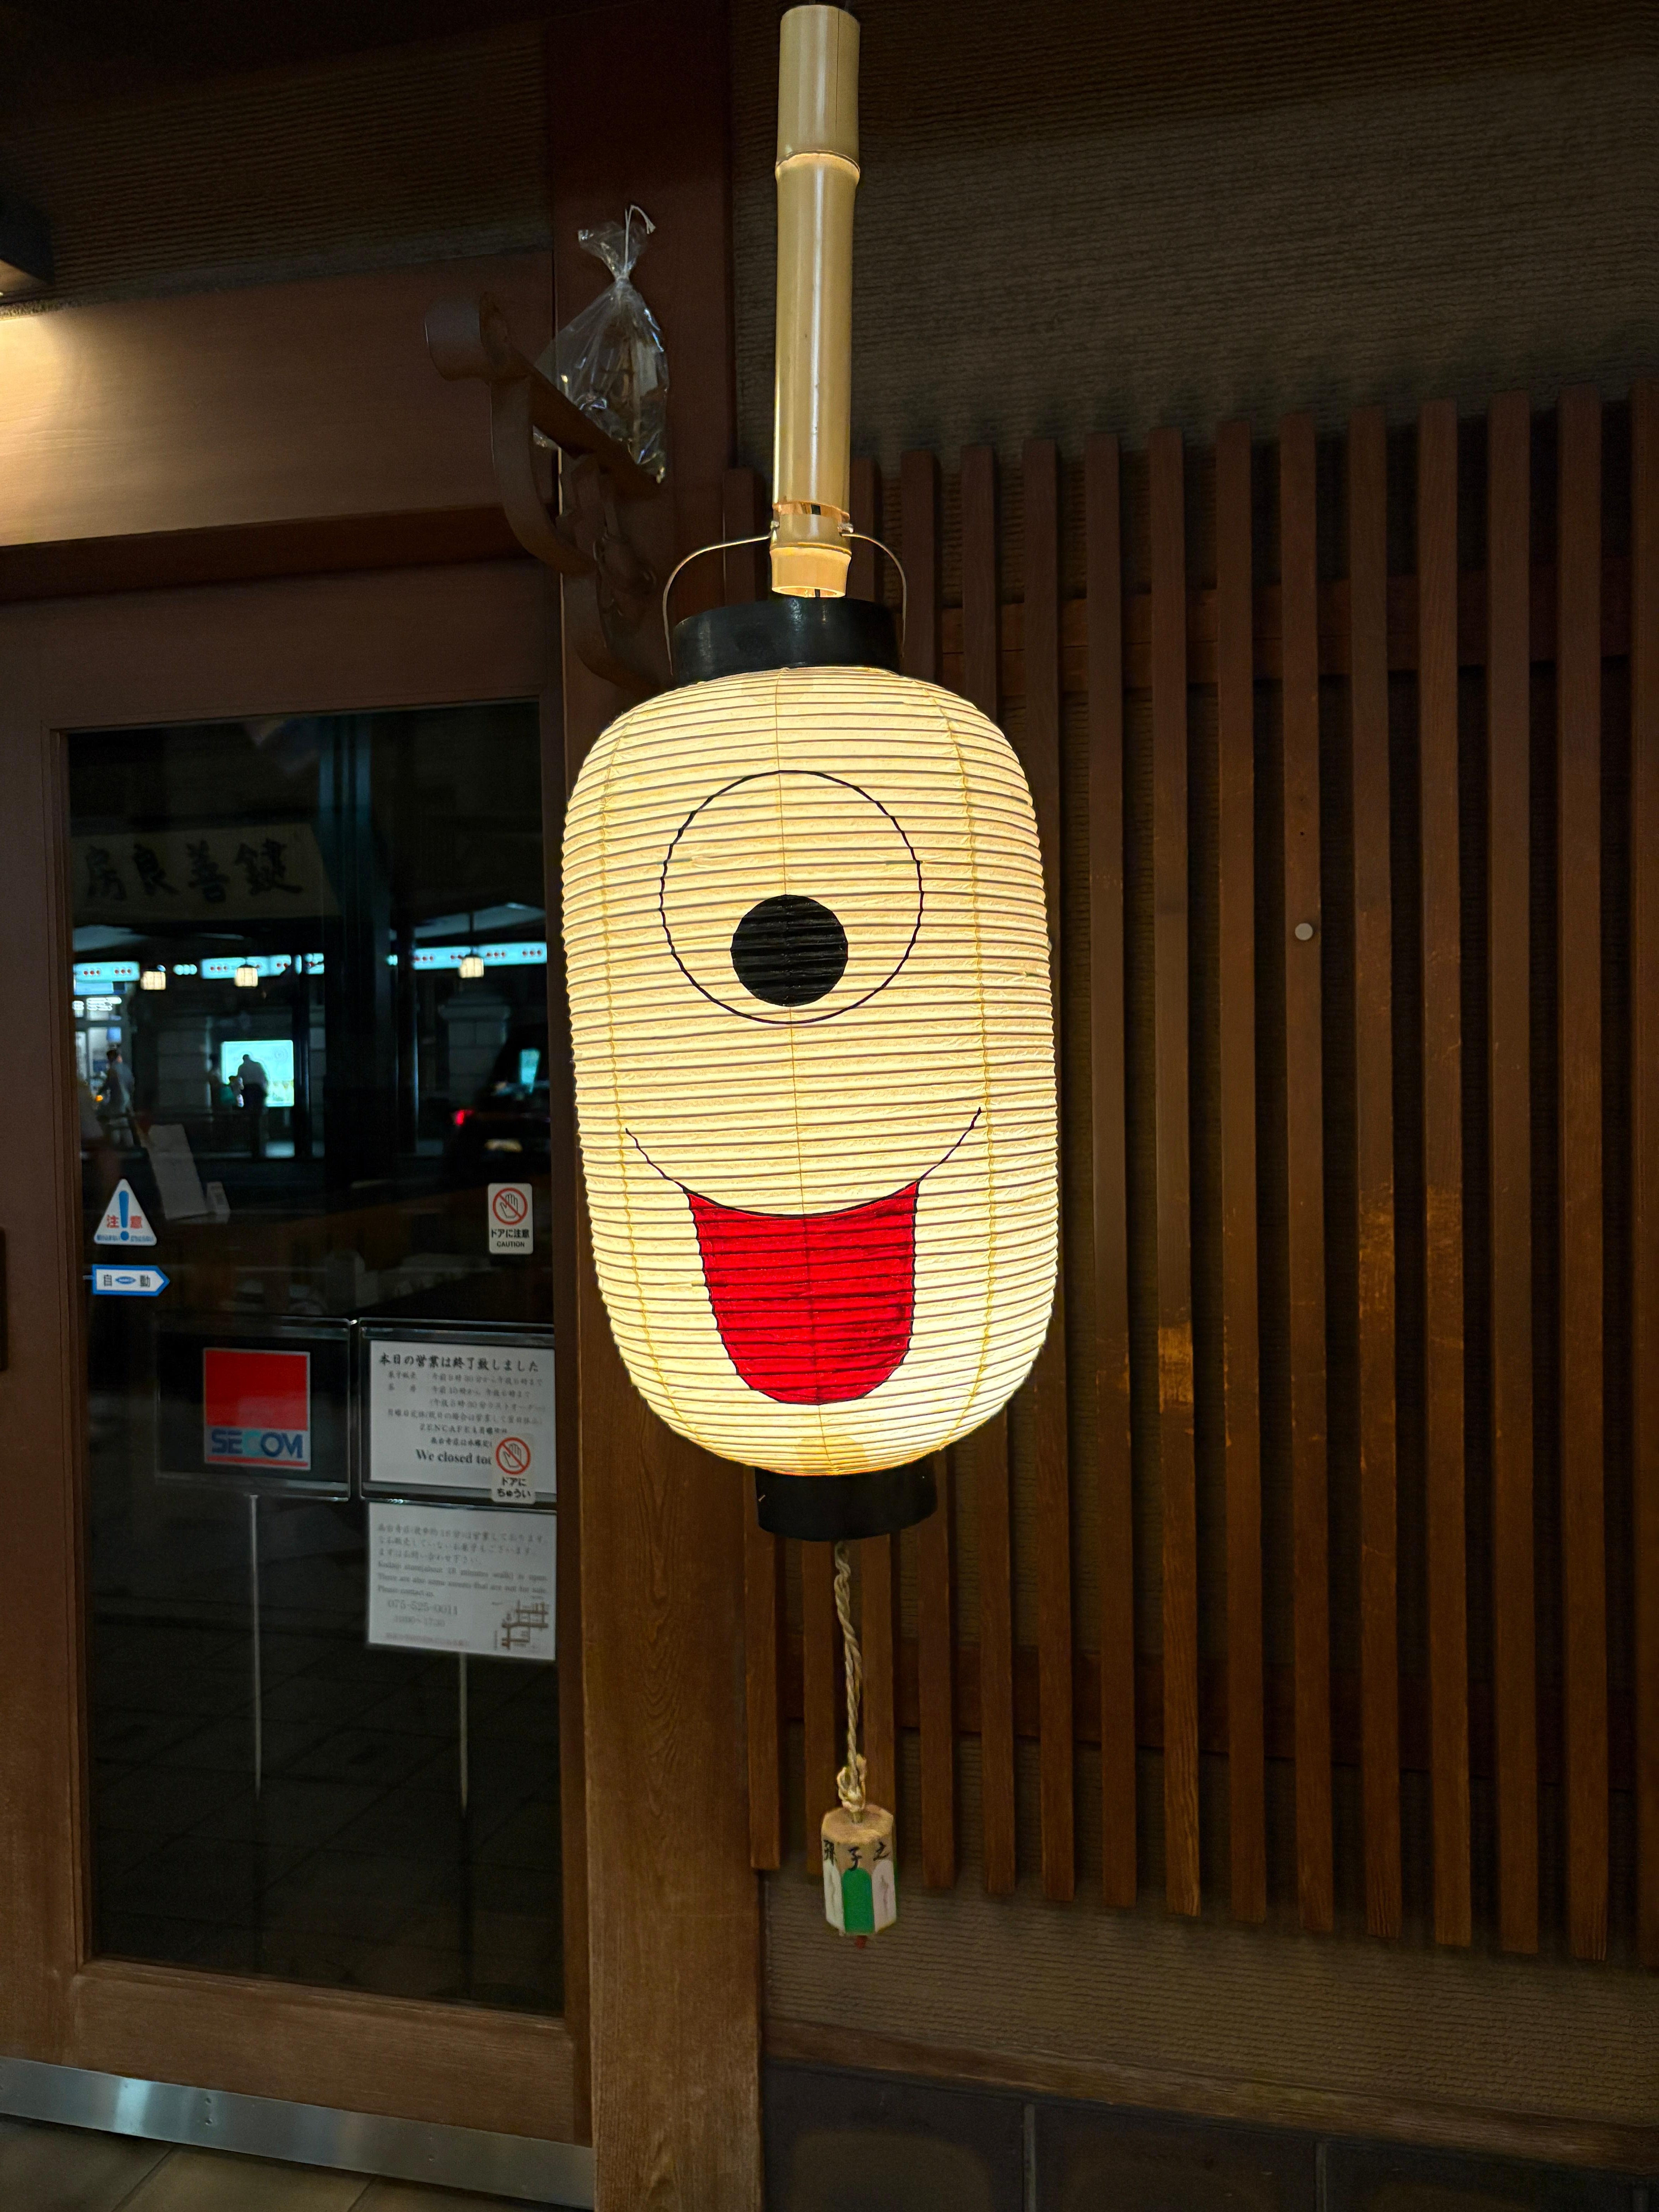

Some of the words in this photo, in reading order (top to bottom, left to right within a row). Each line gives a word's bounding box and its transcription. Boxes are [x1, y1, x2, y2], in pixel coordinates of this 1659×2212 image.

[491, 1228, 530, 1239] ドアに注意
[380, 1352, 539, 1372] 本日の営業は終了致しました
[211, 1427, 303, 1459] SECOM
[416, 1449, 433, 1461] We
[437, 1451, 473, 1464] closed
[502, 1477, 527, 1486] ドアに
[497, 1488, 531, 1498] ちゅうい
